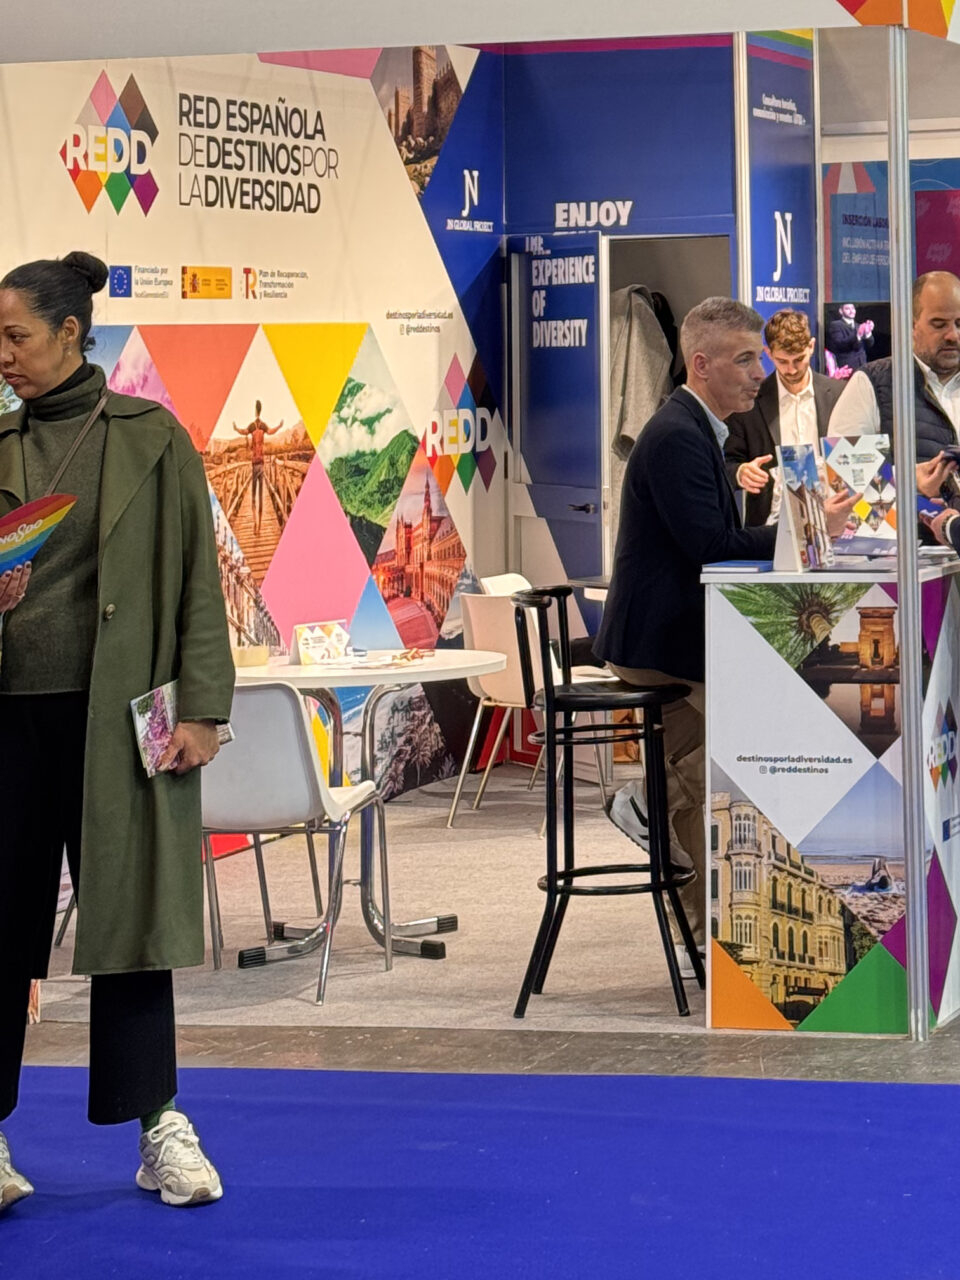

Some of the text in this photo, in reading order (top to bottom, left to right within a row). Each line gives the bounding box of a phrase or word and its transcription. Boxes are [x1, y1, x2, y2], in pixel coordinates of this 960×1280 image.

[179, 93, 326, 142] RED ESPAÑOLA
[66, 124, 152, 175] REDD
[555, 201, 633, 228] ENJOY
[532, 255, 595, 286] EXPERIENCE
[532, 290, 546, 317] OF
[764, 286, 787, 303] GLOBAL
[787, 287, 810, 303] PROJECT
[532, 319, 587, 348] DIVERSITY
[425, 407, 491, 457] REDD
[736, 754, 853, 765] destinosporladiversidad.es
[769, 765, 829, 775] @reddestinos
